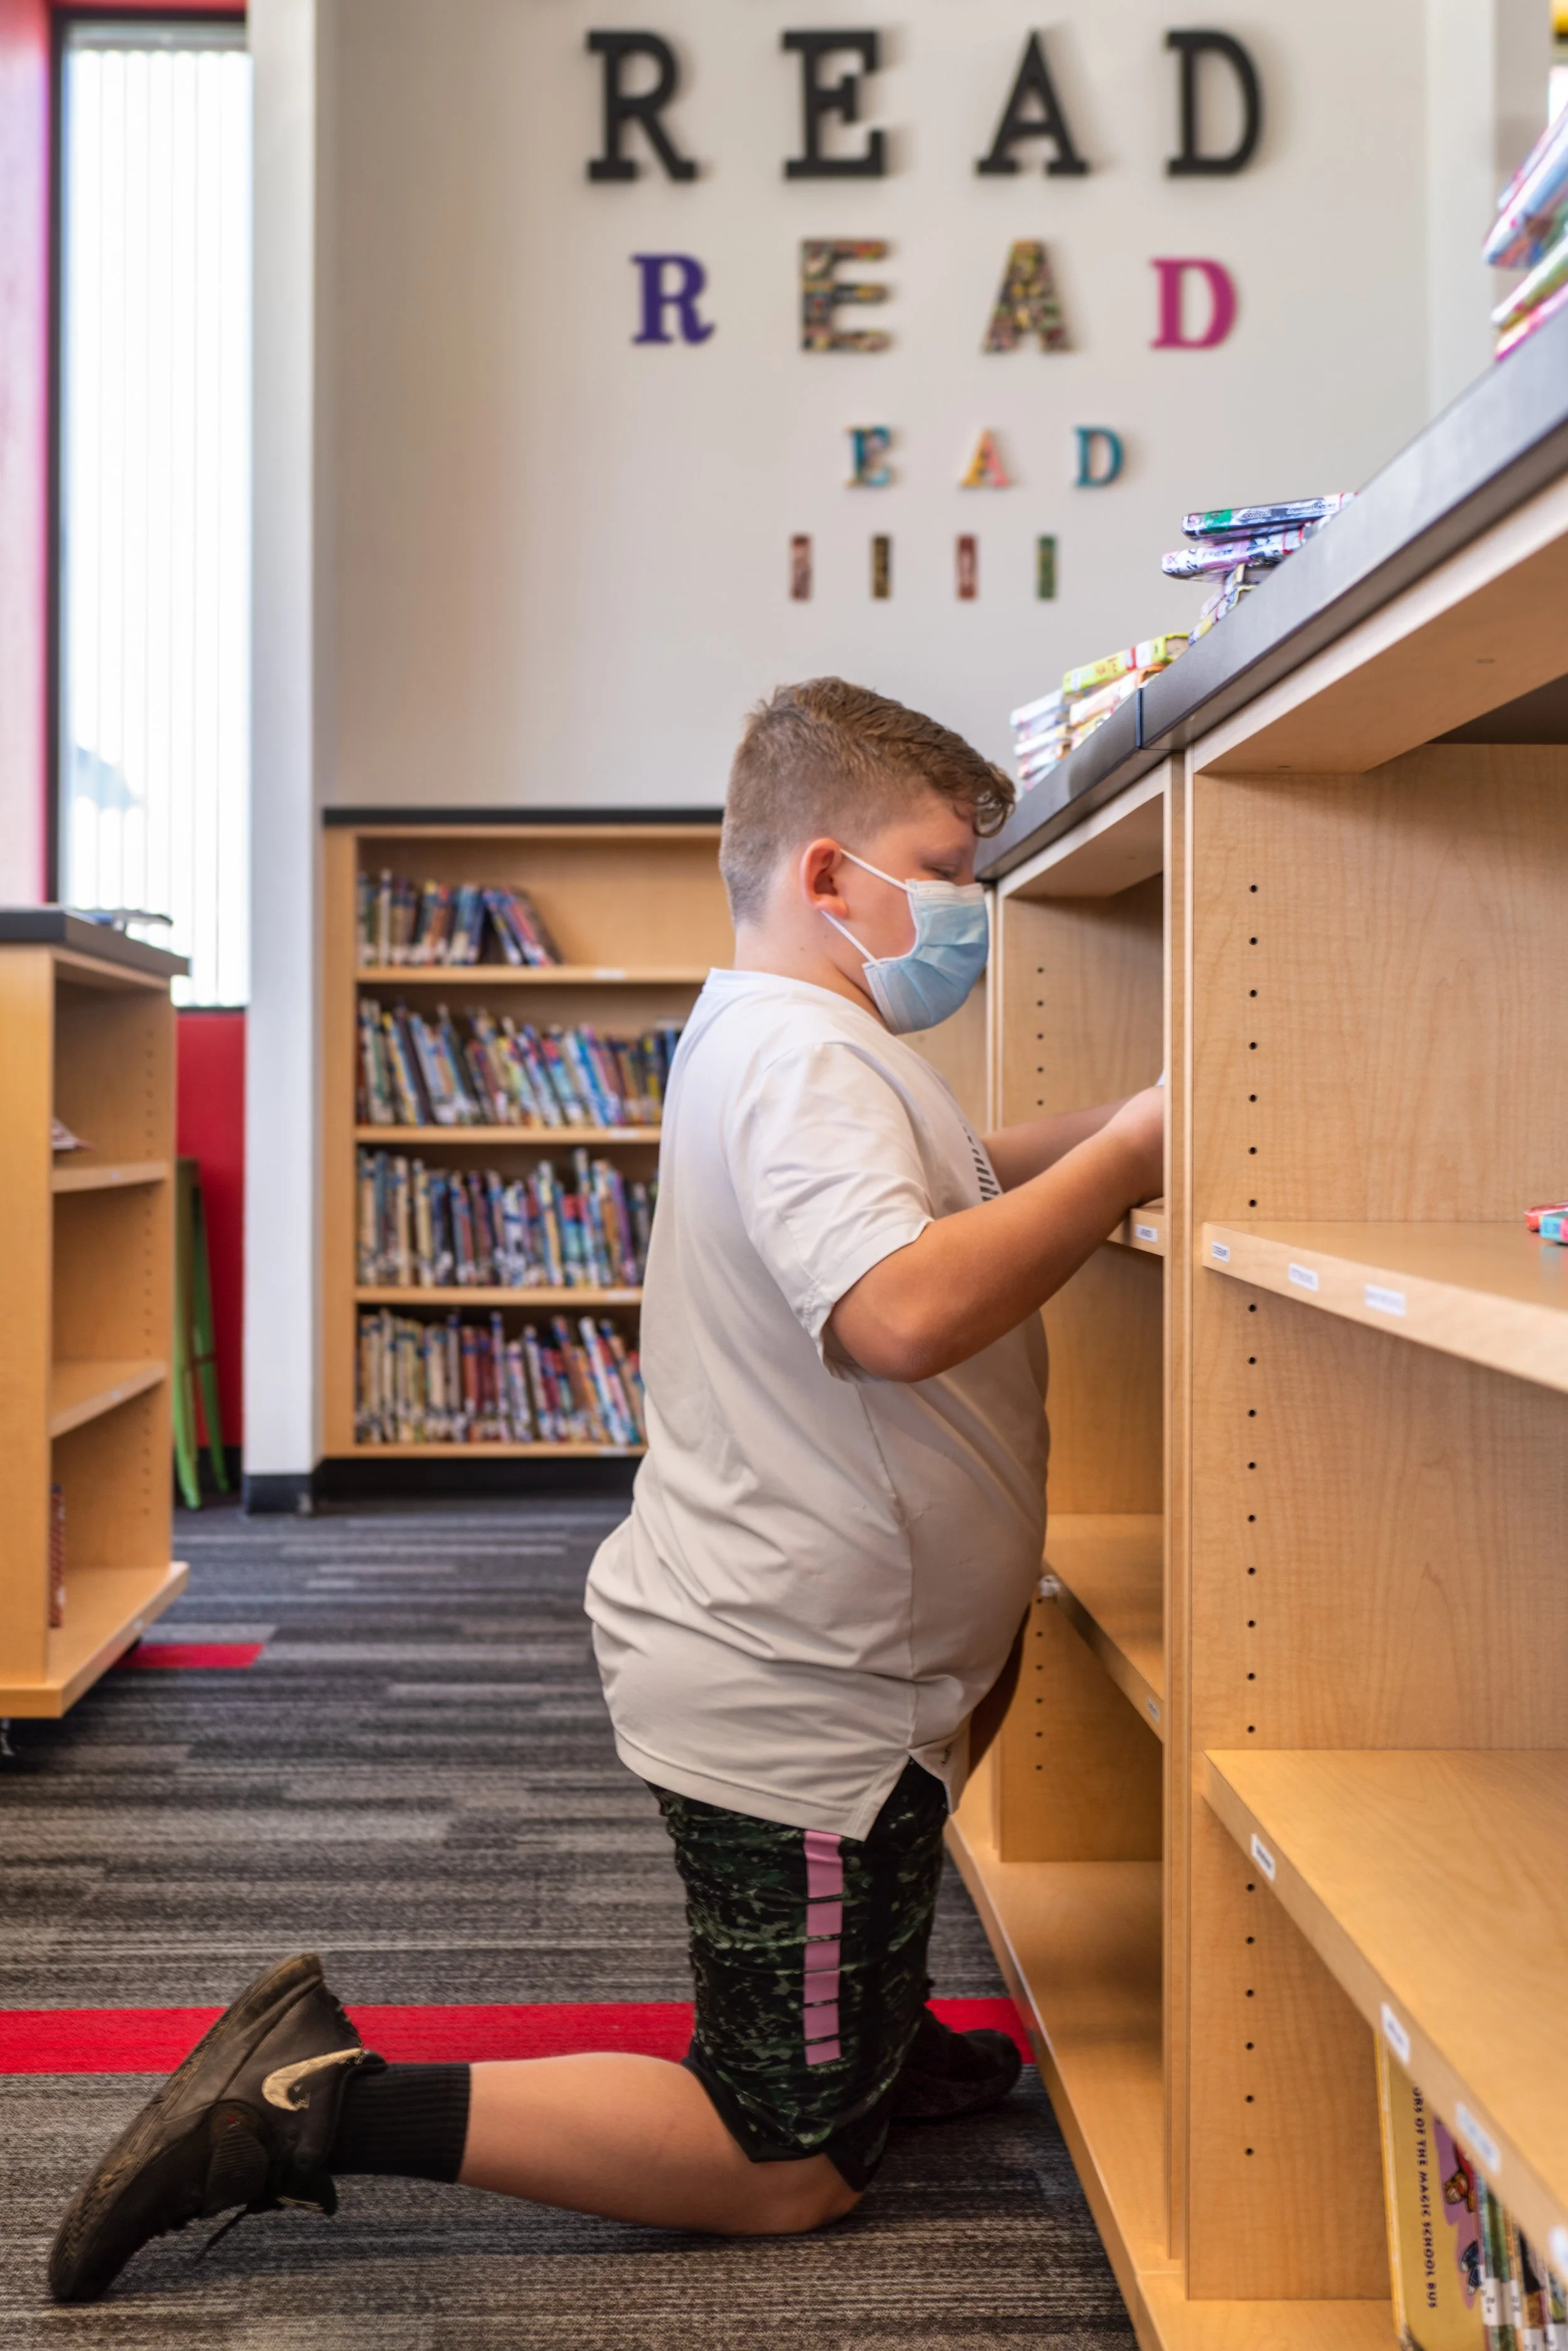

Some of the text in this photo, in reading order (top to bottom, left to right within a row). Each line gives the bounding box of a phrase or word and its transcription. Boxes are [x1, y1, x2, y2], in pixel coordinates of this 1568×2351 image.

[586, 29, 1264, 182] READ
[631, 239, 1239, 353] READ
[847, 426, 1125, 489] EAD
[1414, 2118, 1426, 2135] OF
[1416, 2139, 1428, 2166] THE
[1418, 2171, 1431, 2217] MAGIC
[1421, 2221, 1436, 2277] SCHOOL
[1426, 2282, 1438, 2308] BUS
